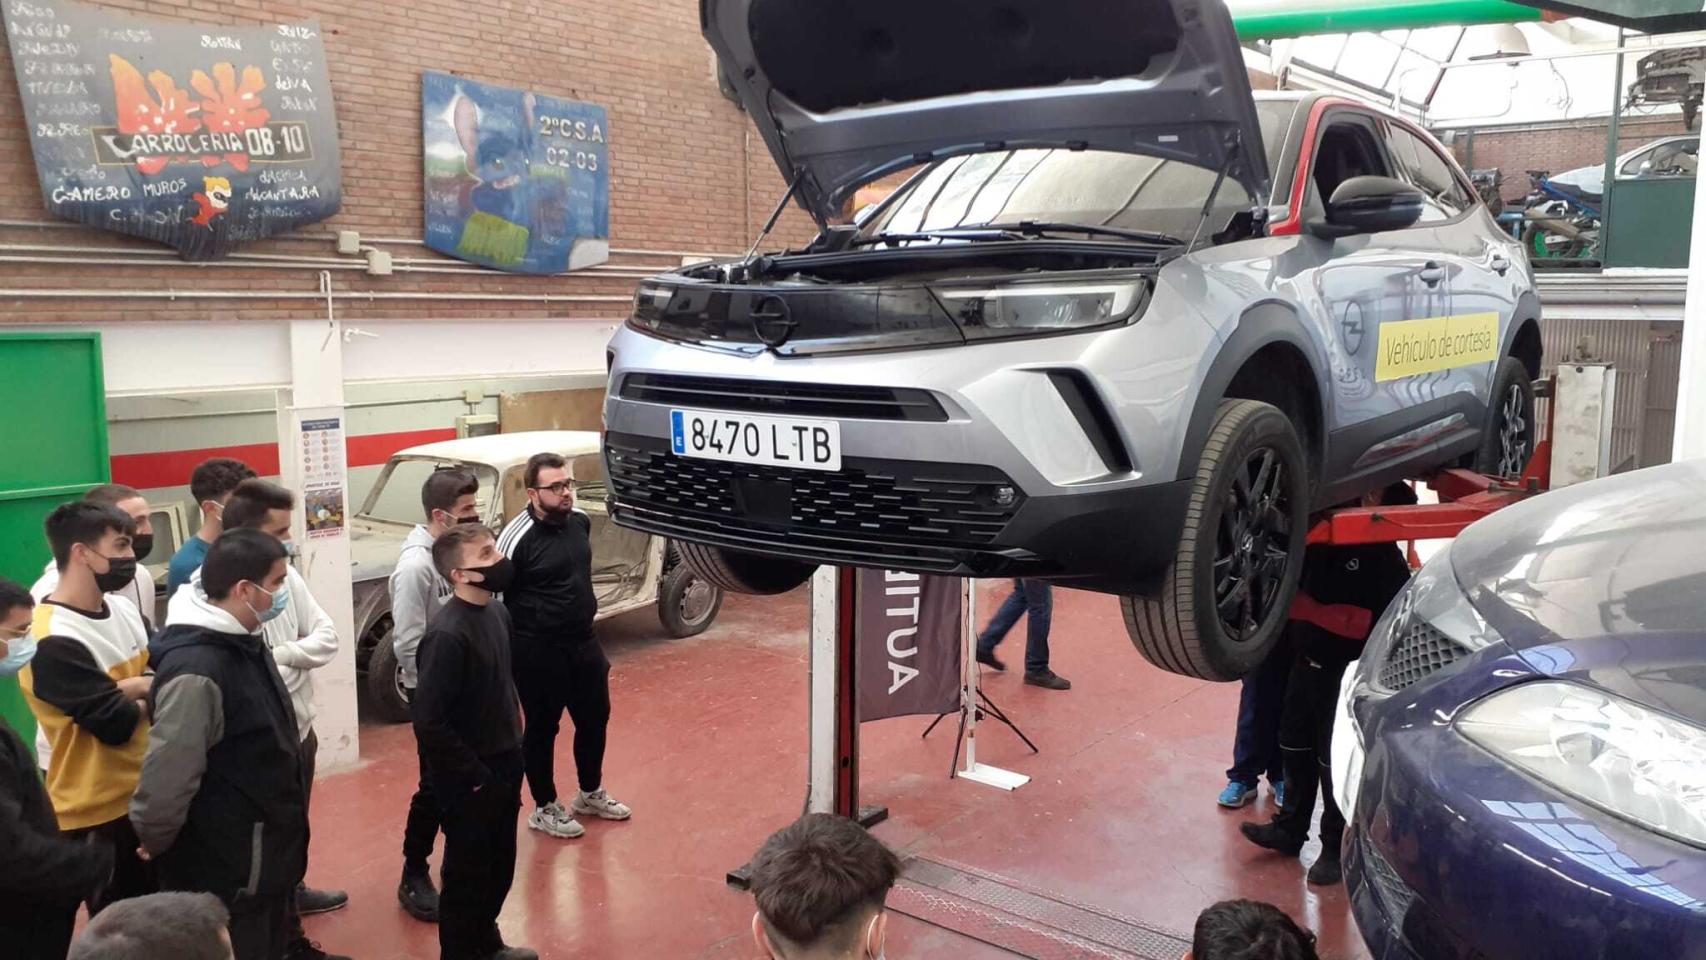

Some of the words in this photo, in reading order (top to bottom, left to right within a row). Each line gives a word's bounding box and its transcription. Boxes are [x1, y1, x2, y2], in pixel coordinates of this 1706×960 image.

[101, 132, 244, 159] CARROCERIA
[245, 125, 305, 156] 08-10
[546, 147, 598, 171] 02-03
[143, 178, 187, 197] MUROS
[1386, 331, 1436, 366] Vehículo
[1438, 330, 1452, 358] de
[1454, 325, 1491, 355] cortesía
[692, 417, 760, 457] 8470
[772, 424, 831, 463] LTB
